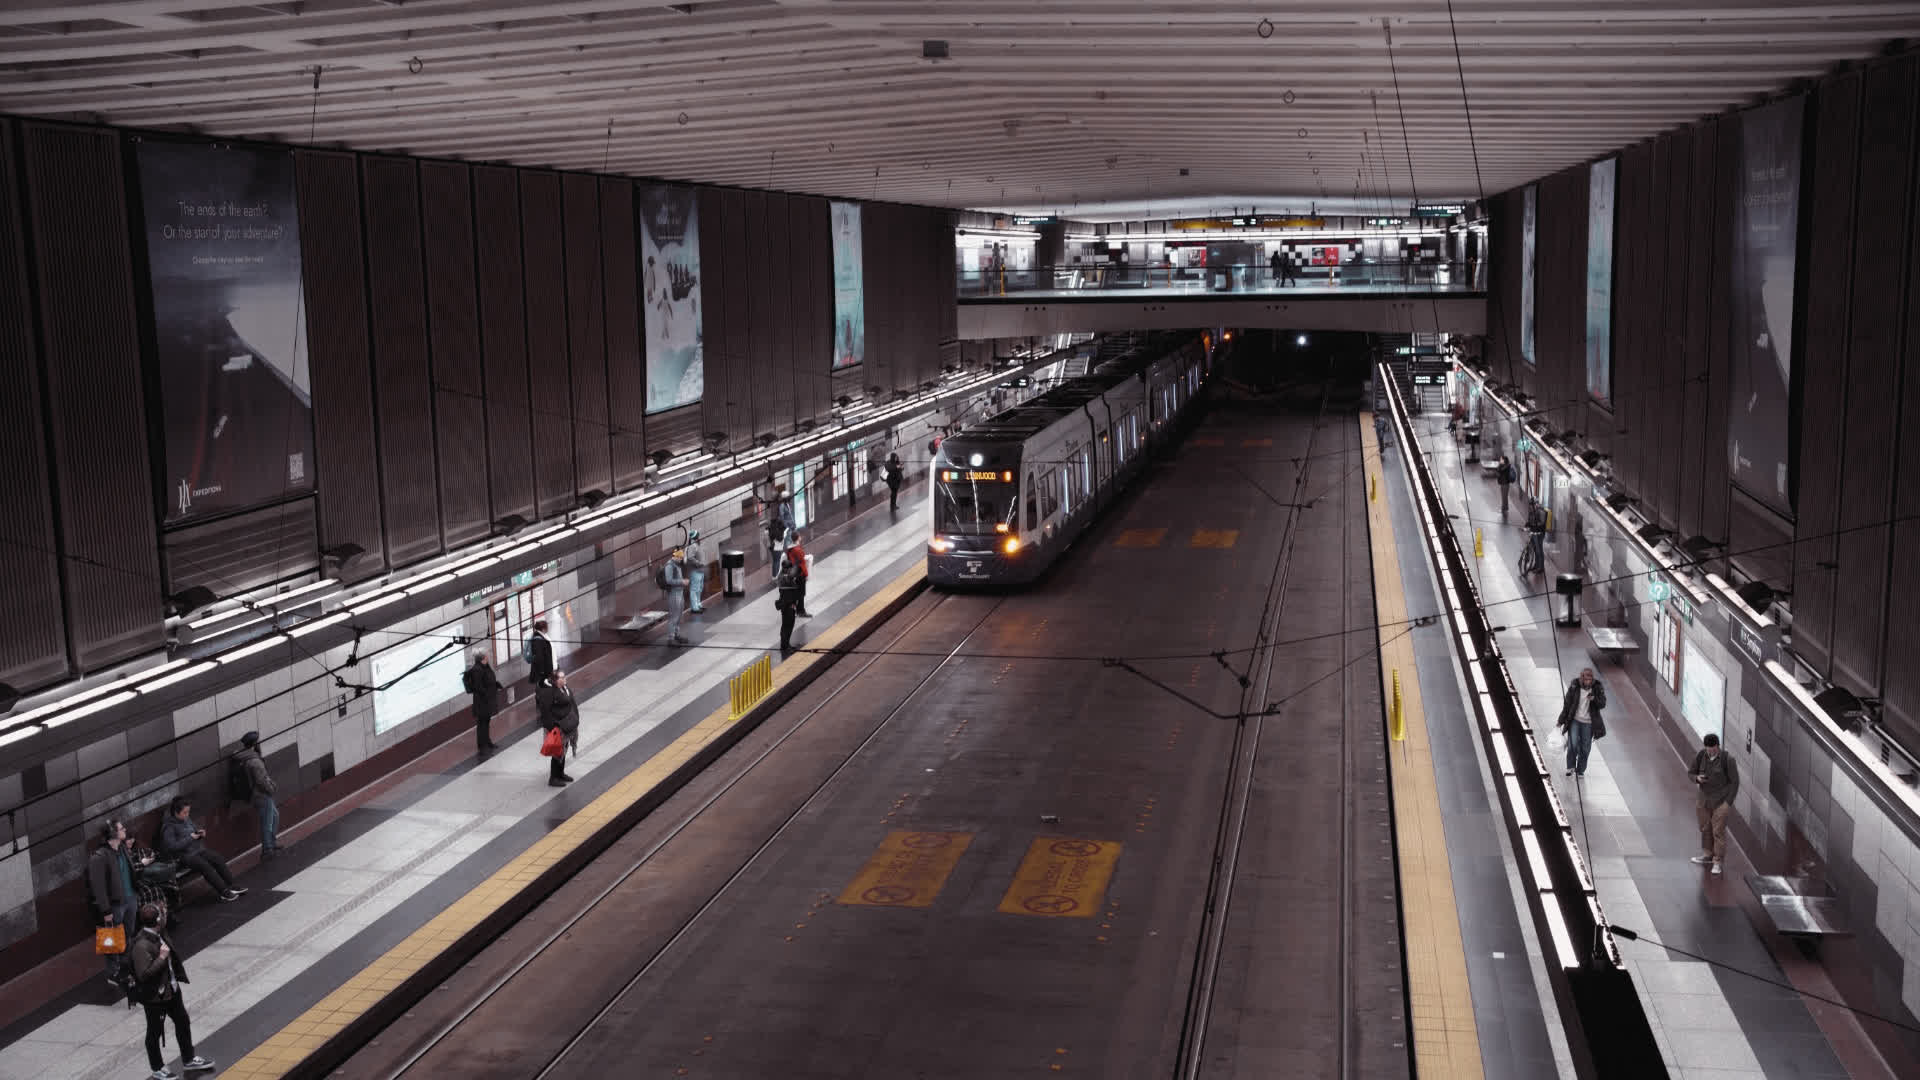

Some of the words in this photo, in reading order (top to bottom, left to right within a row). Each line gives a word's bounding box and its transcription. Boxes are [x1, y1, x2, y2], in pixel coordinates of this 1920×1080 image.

[178, 200, 195, 216] The
[197, 200, 216, 217] ends
[228, 200, 242, 216] the
[163, 224, 176, 240] Or
[178, 224, 192, 240] the
